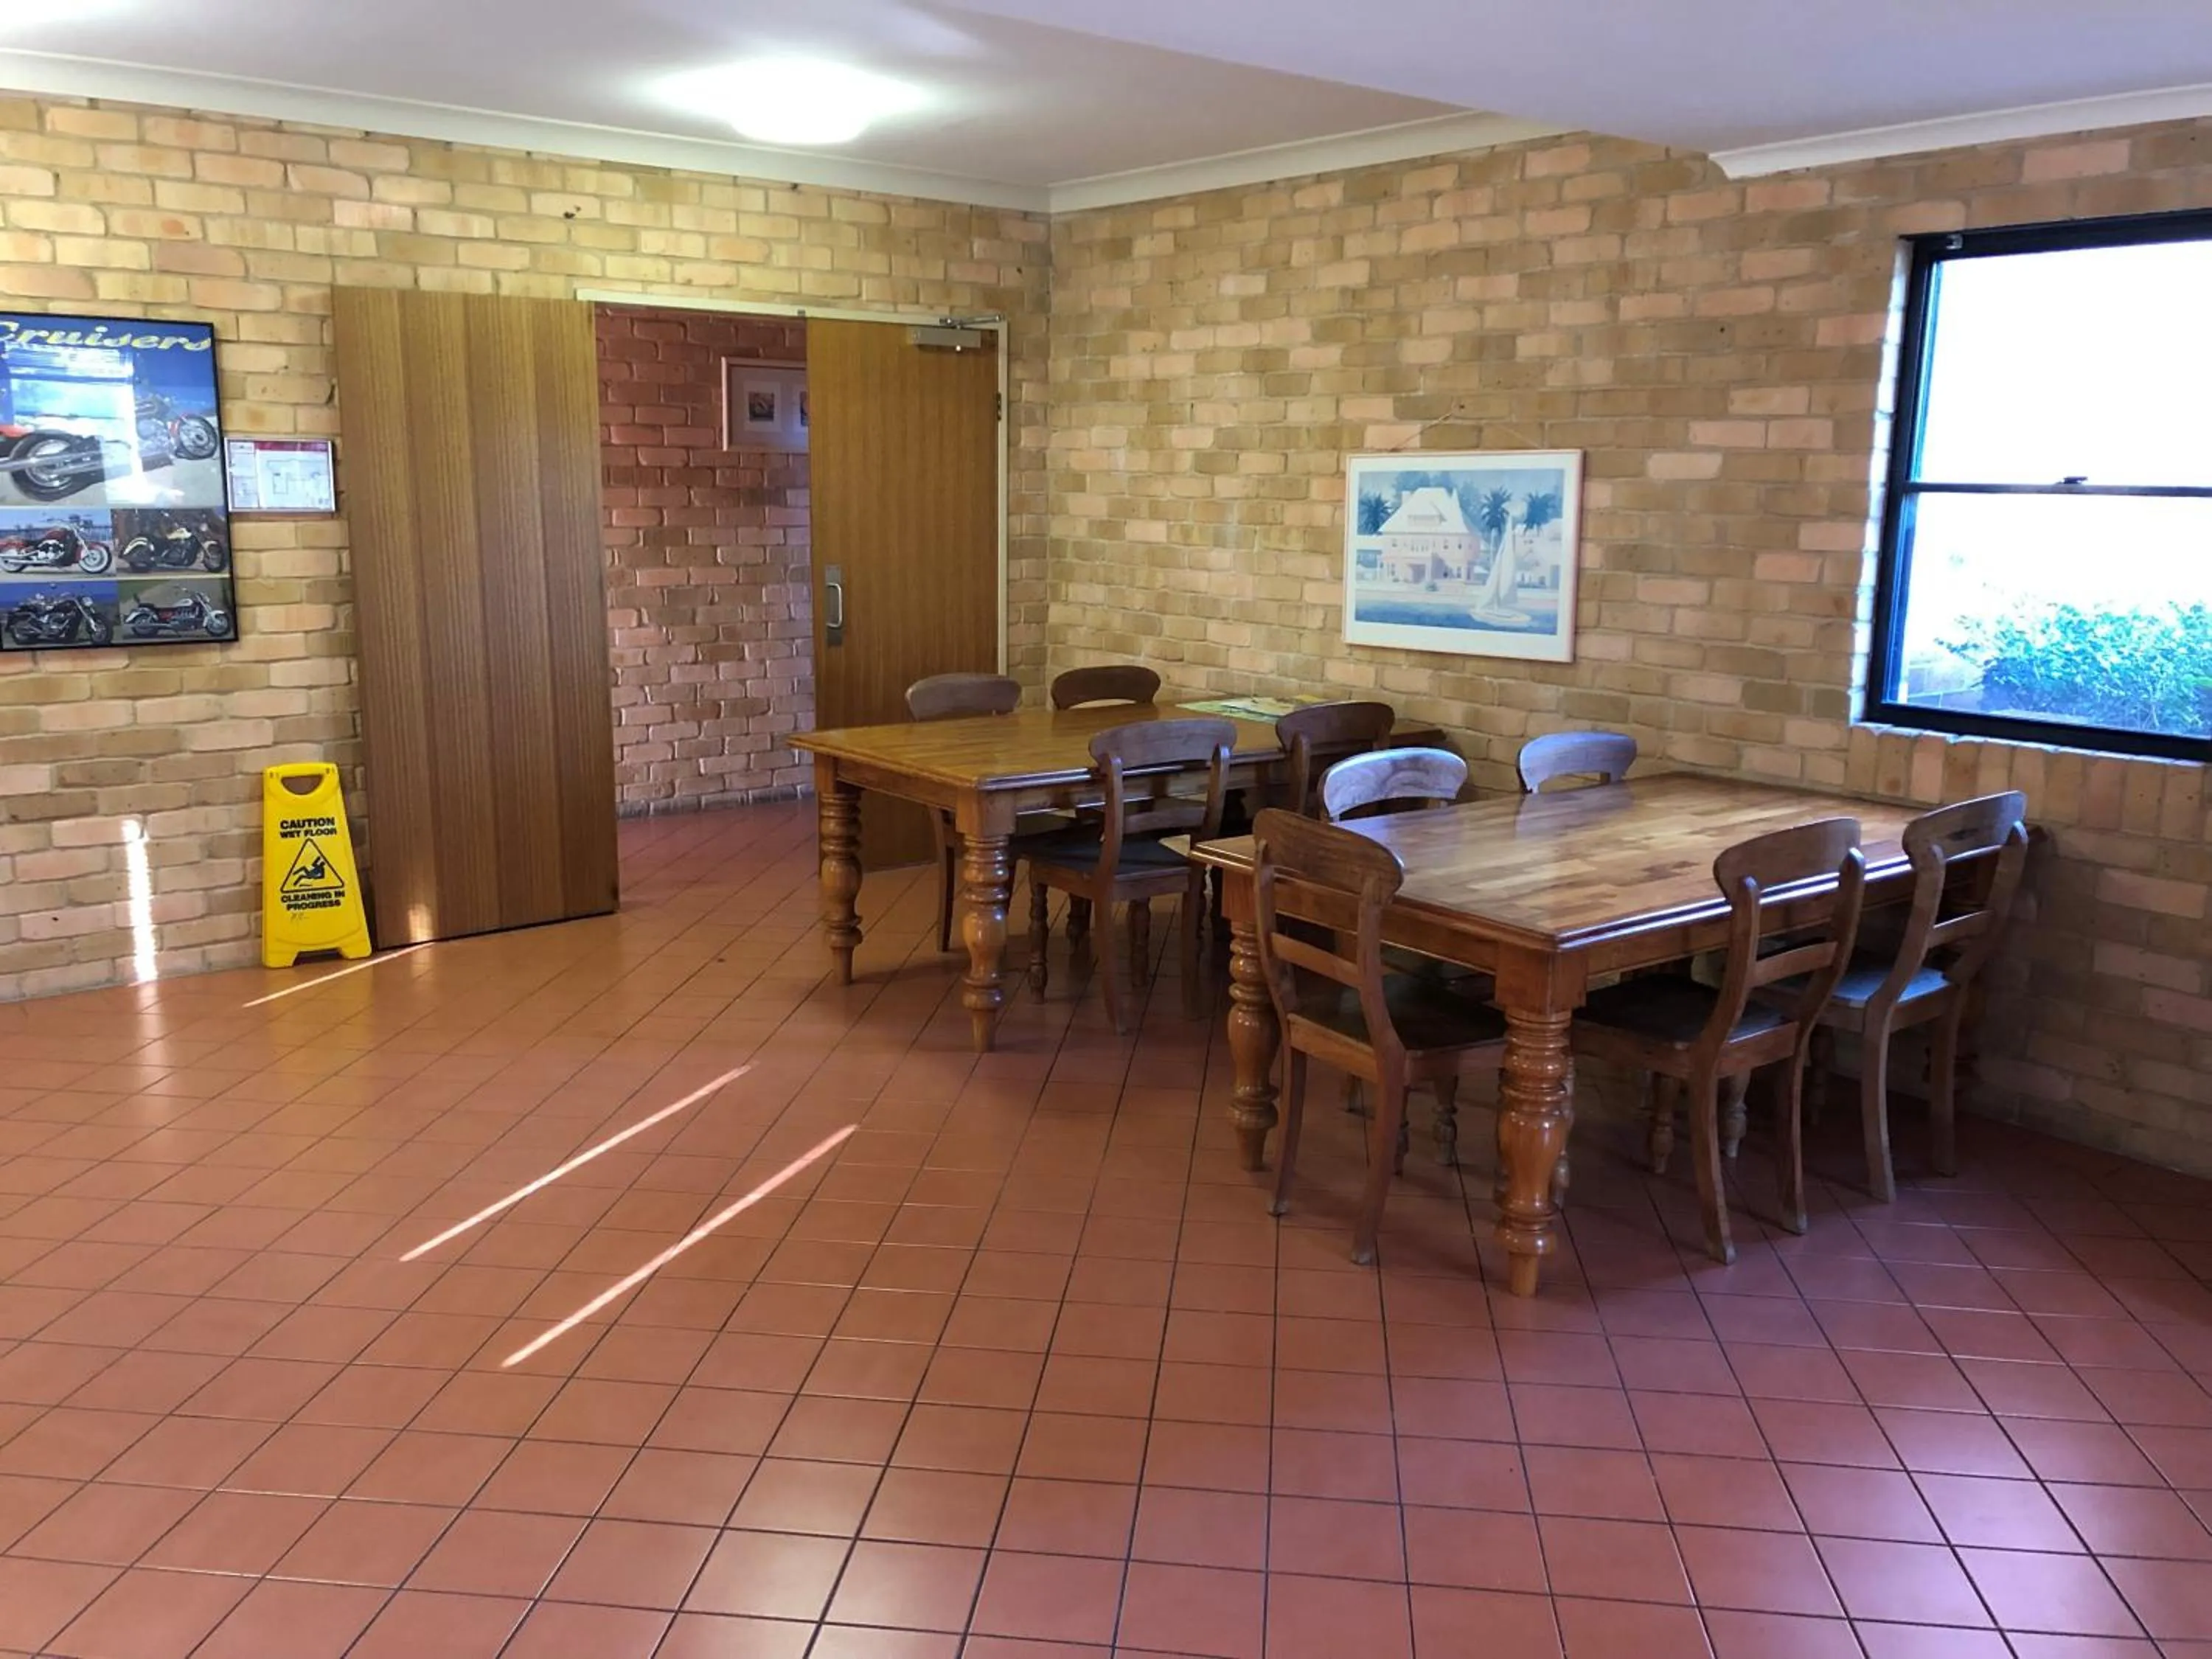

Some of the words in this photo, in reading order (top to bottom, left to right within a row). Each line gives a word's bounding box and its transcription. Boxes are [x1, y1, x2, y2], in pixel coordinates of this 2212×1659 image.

[0, 320, 212, 351] Cruisers
[280, 817, 335, 830] CAUTION
[280, 830, 301, 838] WET
[304, 828, 337, 837] FLOOR
[281, 892, 332, 903] CLEANING
[286, 899, 341, 911] PROGRESS
